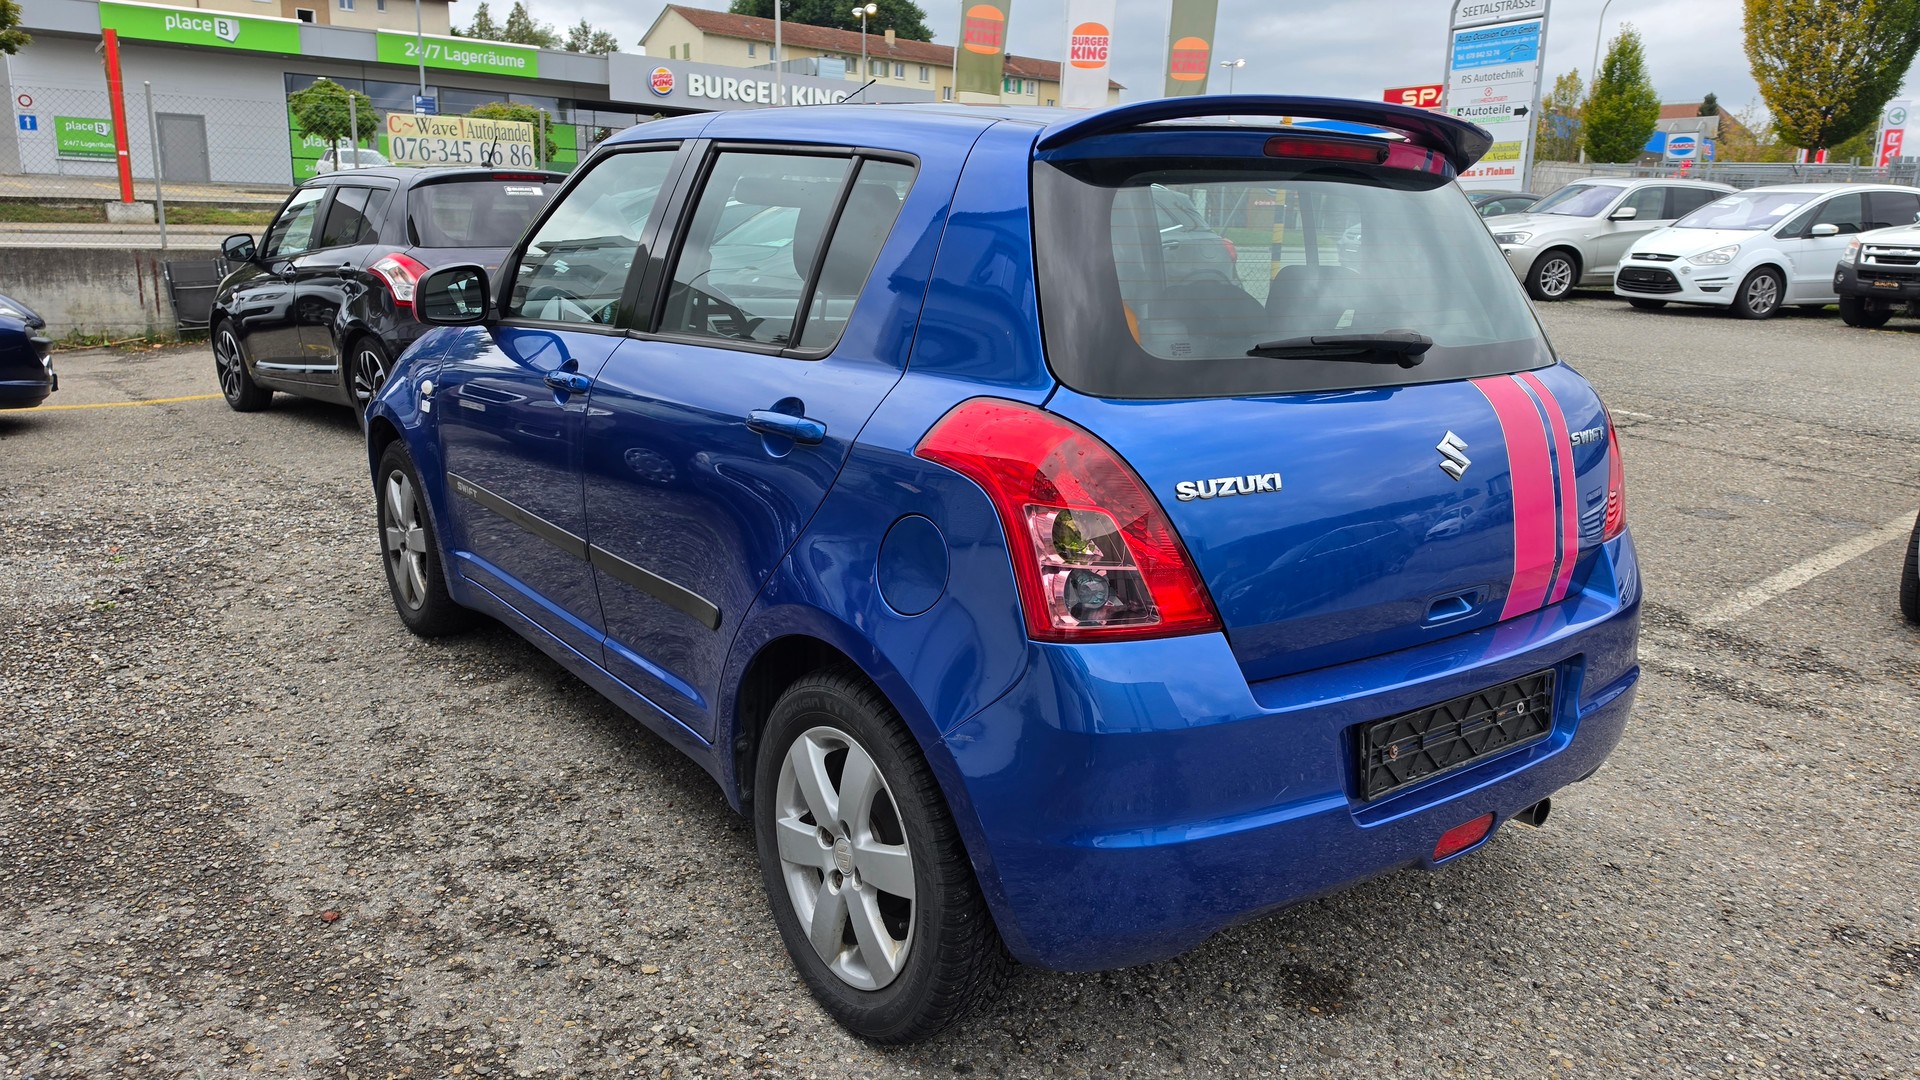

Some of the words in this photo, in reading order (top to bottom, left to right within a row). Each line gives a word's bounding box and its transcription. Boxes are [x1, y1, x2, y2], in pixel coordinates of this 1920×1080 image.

[1462, 0, 1536, 18] SEETALSTRASSE
[165, 13, 212, 32] place
[965, 30, 1003, 47] KING
[1072, 36, 1109, 47] BURGER
[1458, 34, 1472, 43] Auto
[1473, 31, 1499, 41] Occasion
[404, 42, 440, 59] 24/7
[444, 46, 525, 68] Lagerräume
[1071, 46, 1108, 60] KING
[1171, 61, 1207, 73] KING
[653, 79, 673, 87] KING
[1461, 74, 1472, 84] RS
[1473, 68, 1524, 83] Autotechnik
[688, 73, 785, 105] BURGER
[791, 85, 848, 106] KING
[1465, 105, 1511, 116] Autoteile
[65, 121, 94, 131] place
[467, 121, 532, 143] Autohandel
[393, 136, 473, 163] 076-345
[480, 142, 503, 165] 66
[510, 144, 532, 167] 86
[1493, 151, 1520, 160] Verkauf
[1486, 165, 1515, 177] Flohmi
[1570, 426, 1604, 446] SWIFT
[456, 481, 478, 498] SWIFT
[1175, 473, 1282, 501] SUZUKI
